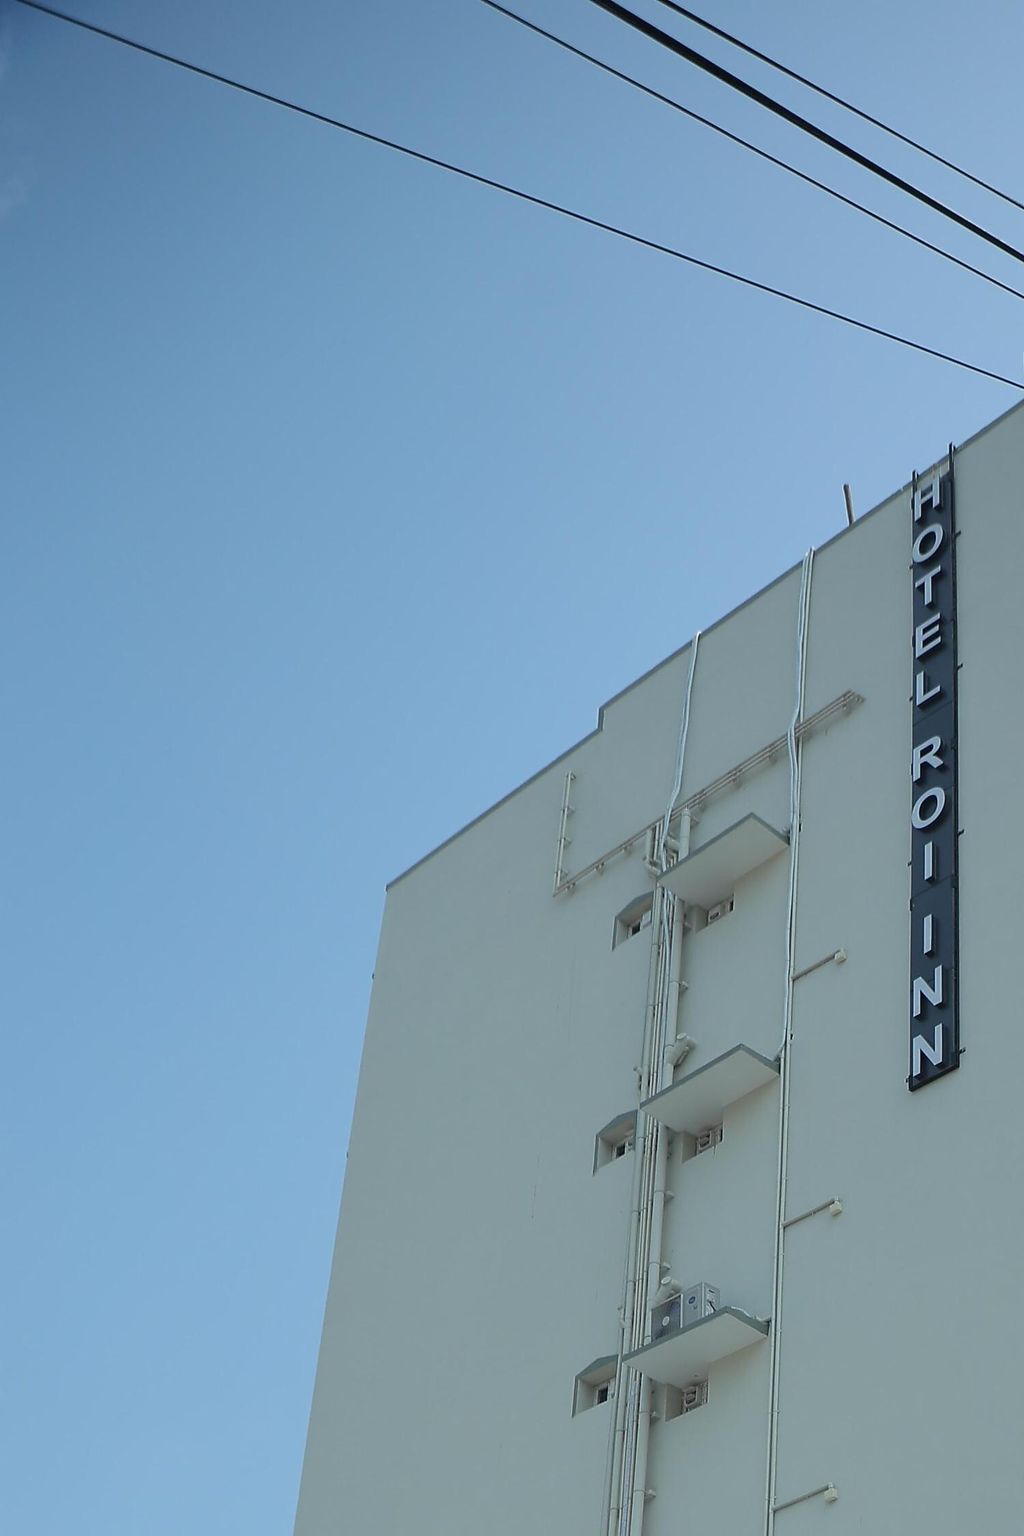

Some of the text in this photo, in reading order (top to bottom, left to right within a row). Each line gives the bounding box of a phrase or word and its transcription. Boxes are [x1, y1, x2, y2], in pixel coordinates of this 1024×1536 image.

[911, 470, 946, 1077] HOTEL ROI INN
